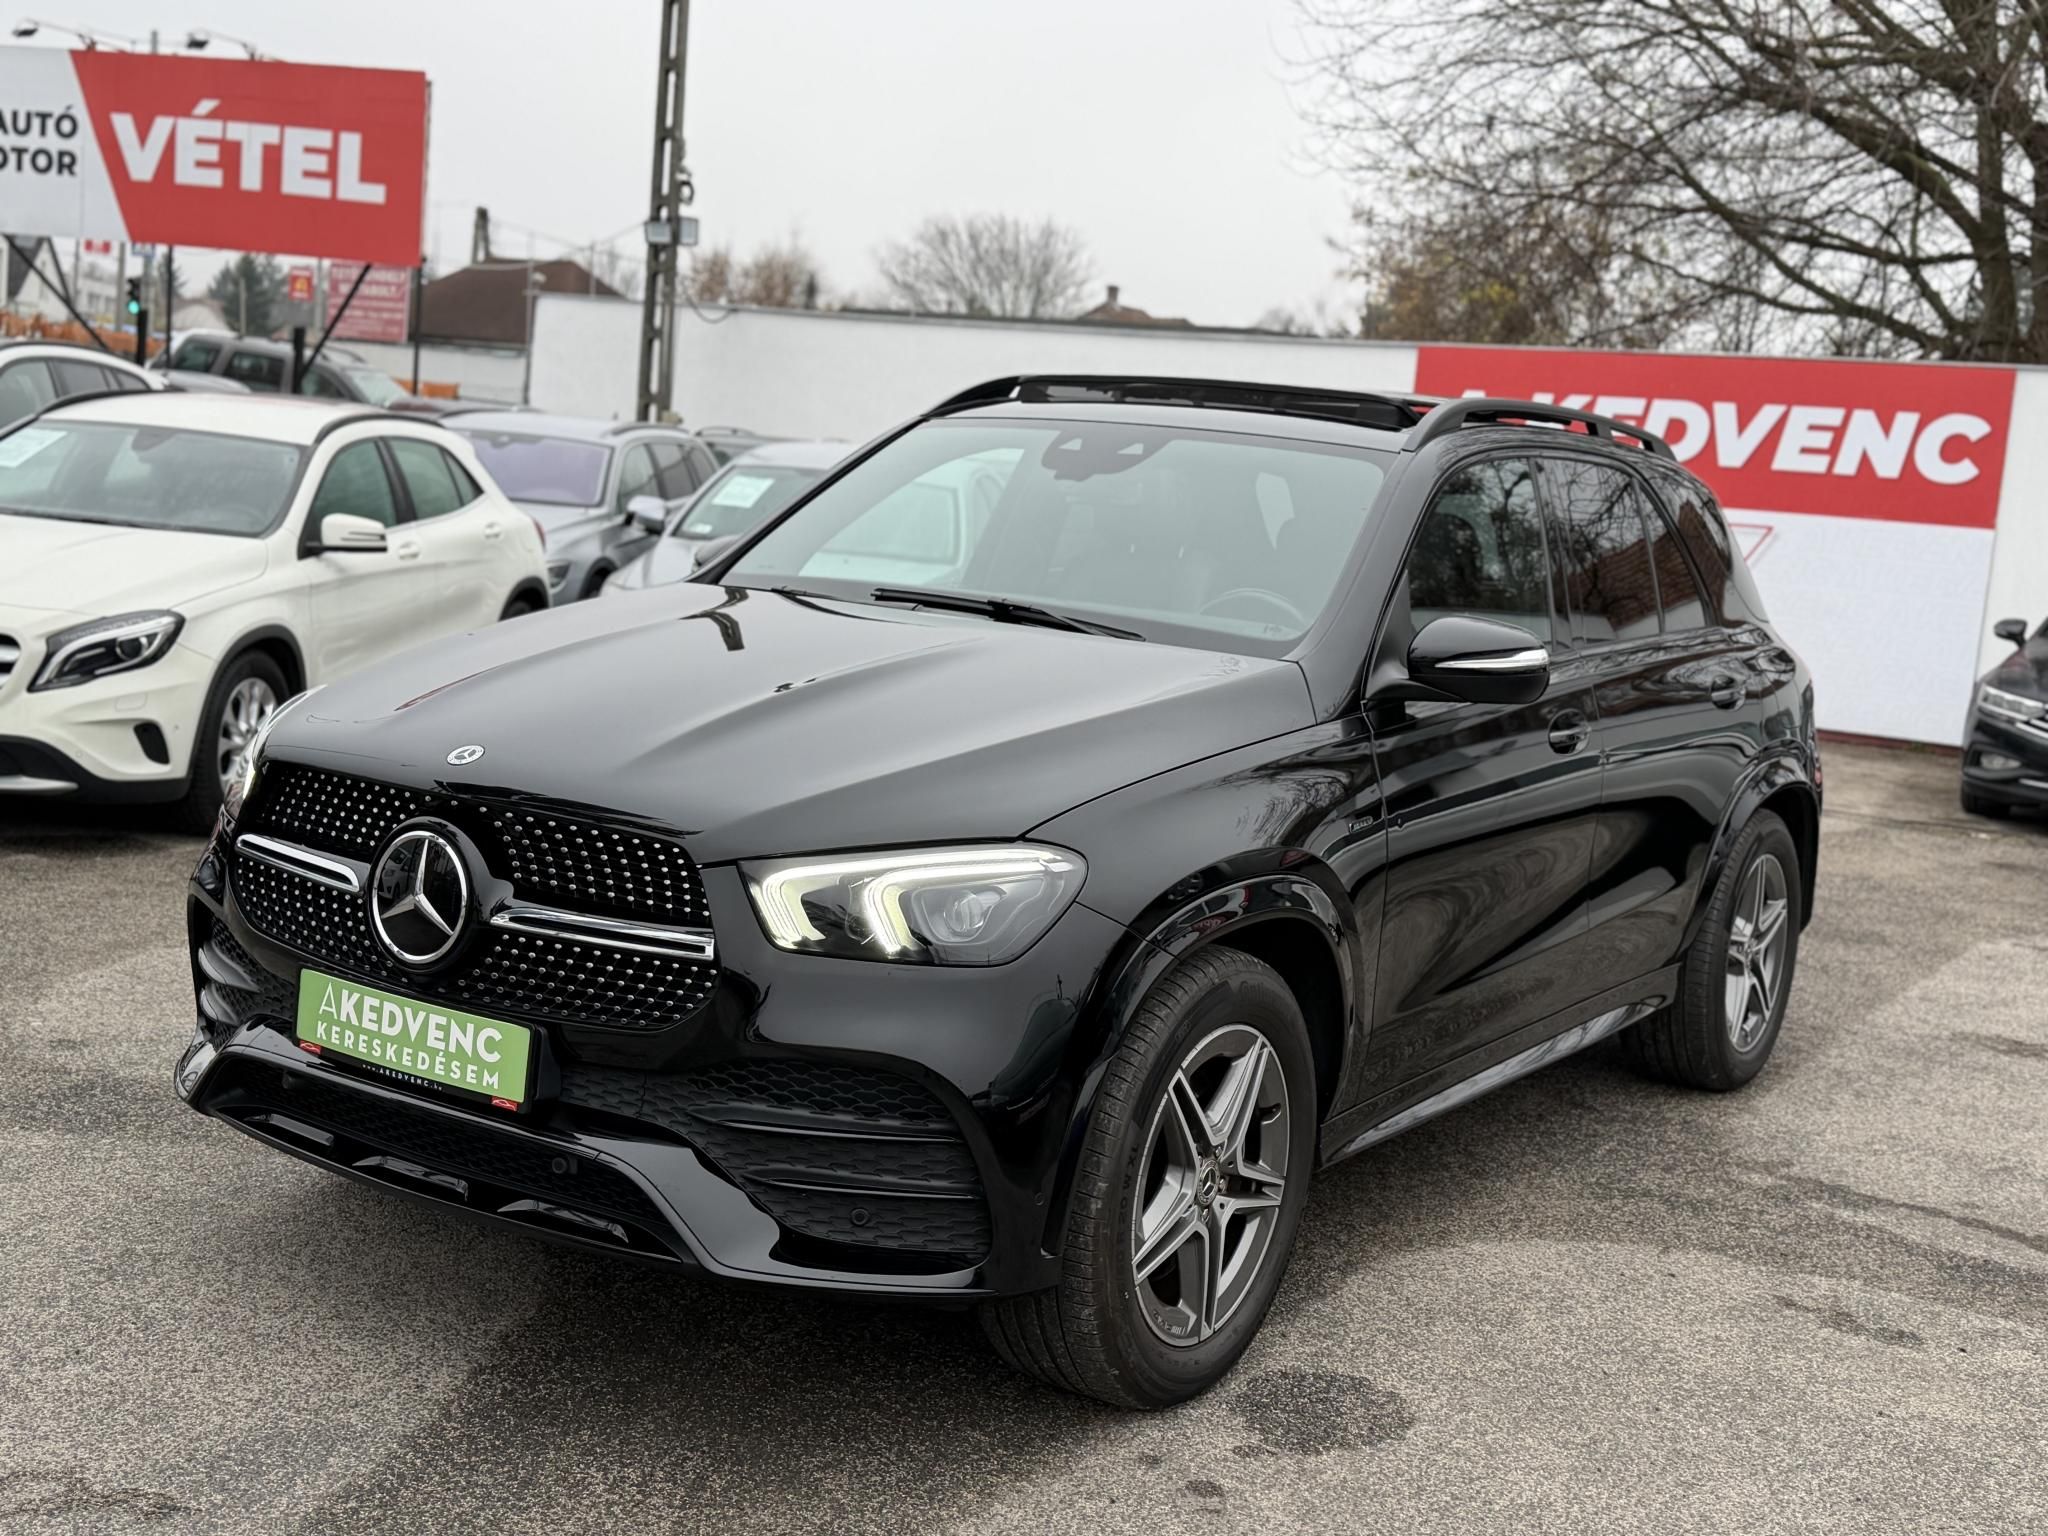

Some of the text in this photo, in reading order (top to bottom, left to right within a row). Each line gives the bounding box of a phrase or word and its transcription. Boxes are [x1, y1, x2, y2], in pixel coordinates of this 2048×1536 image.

[109, 98, 387, 205] VÉTEL
[316, 1020, 499, 1090] KERESKEDÉSEM
[318, 982, 503, 1063] AKEDVENC
